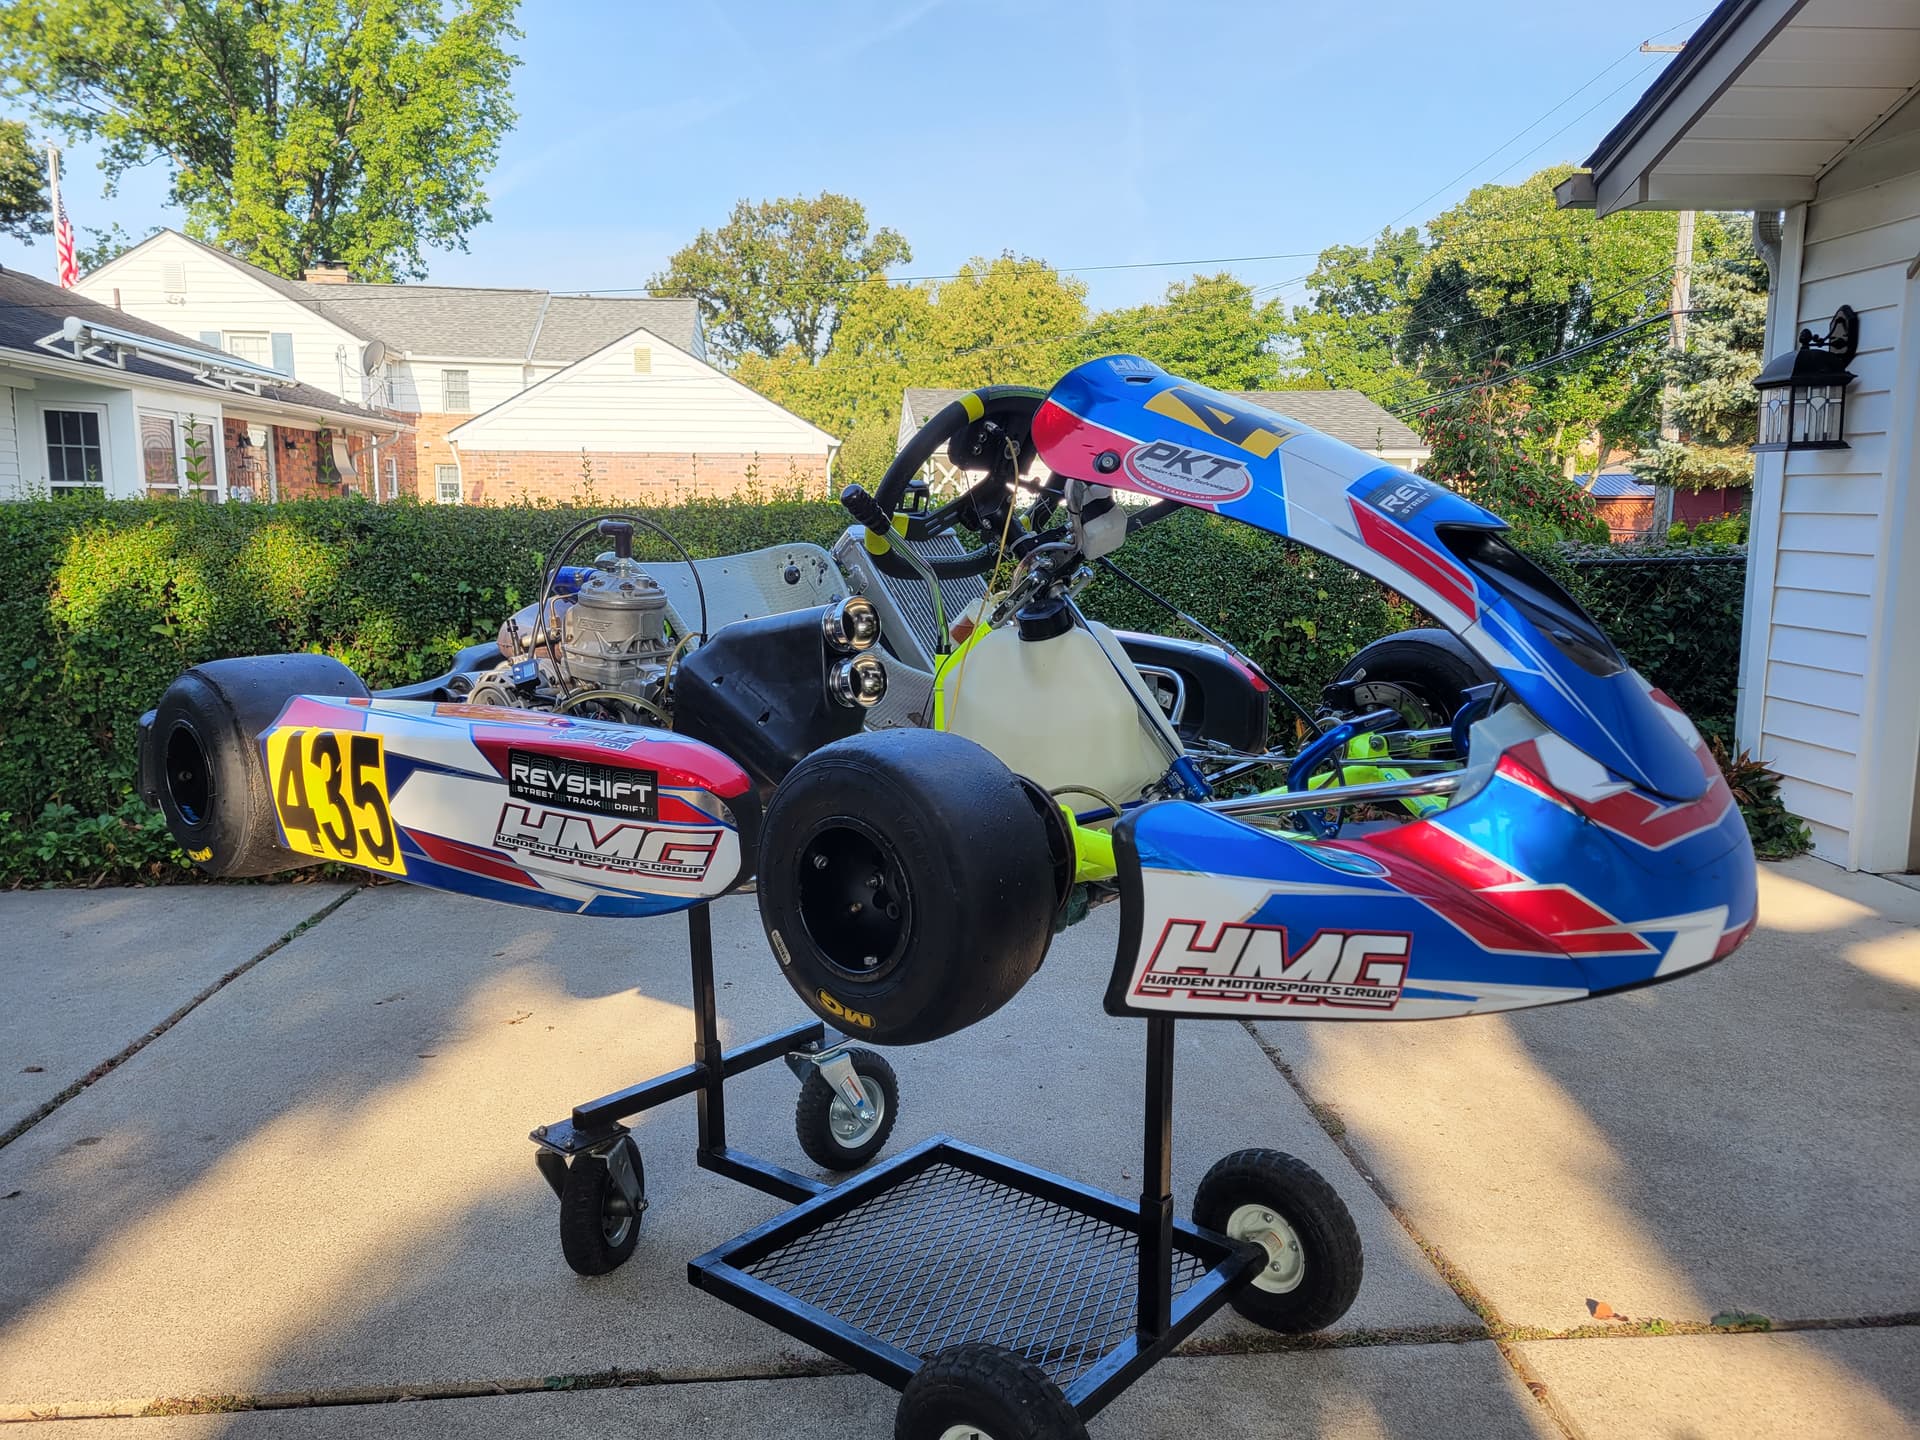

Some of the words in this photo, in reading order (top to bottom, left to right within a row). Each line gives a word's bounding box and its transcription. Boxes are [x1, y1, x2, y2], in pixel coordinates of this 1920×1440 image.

[1169, 388, 1290, 446] 4
[1136, 442, 1242, 480] PKT
[1401, 492, 1431, 514] STREET
[277, 731, 395, 866] 435
[511, 763, 652, 803] REVSHIFT
[517, 785, 554, 799] STREET
[566, 795, 601, 807] TRACK
[614, 804, 647, 814] DRIFT
[493, 803, 723, 882] HMG
[497, 835, 547, 851] HARDEN
[548, 846, 650, 870] MOTORSPORTS
[651, 862, 704, 875] GROUP
[1134, 918, 1413, 1010] HMG
[1144, 973, 1215, 988] HARDEN
[1216, 978, 1341, 996] MOTORSPORTS
[1343, 986, 1398, 997] GROUP
[820, 990, 872, 1029] MG
